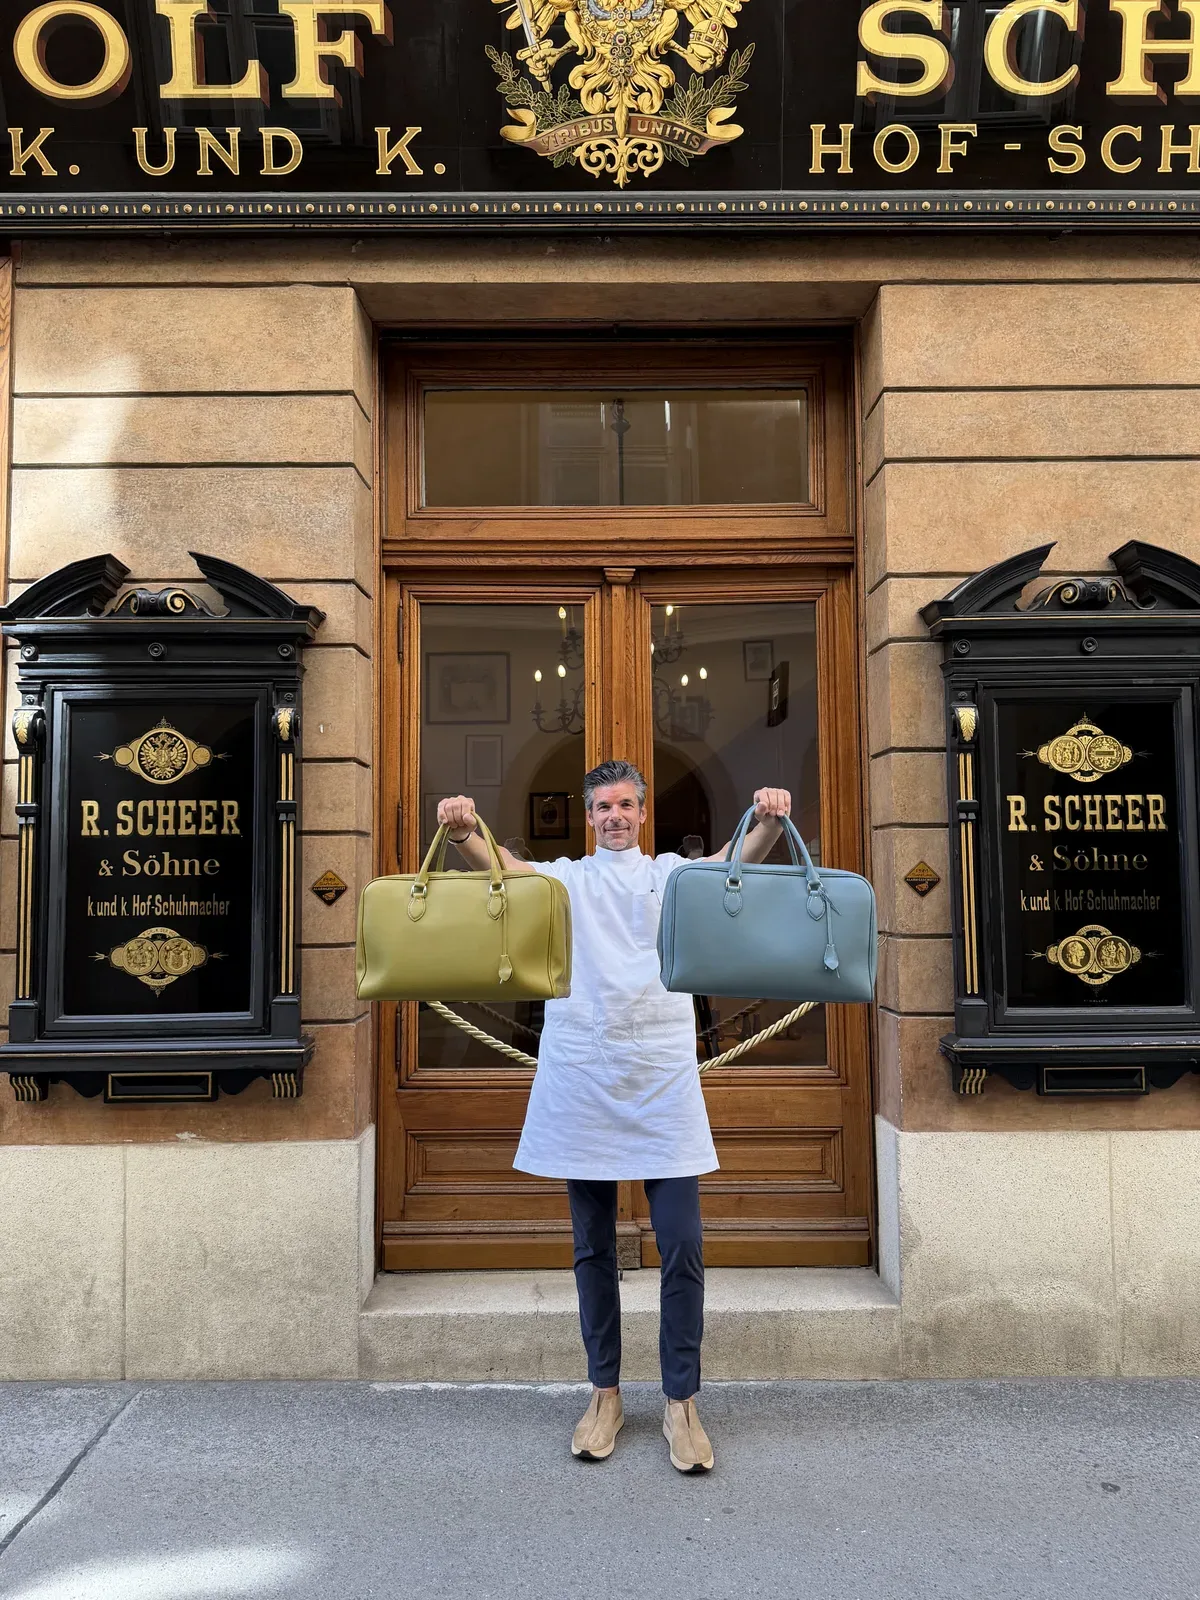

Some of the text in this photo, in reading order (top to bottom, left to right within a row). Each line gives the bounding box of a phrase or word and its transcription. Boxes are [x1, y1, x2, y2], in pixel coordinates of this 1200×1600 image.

[13, 0, 1200, 101] OLF SCH
[637, 119, 701, 149] UNITIS
[8, 127, 80, 176] K.
[132, 127, 303, 176] UND
[374, 127, 447, 176] K.
[81, 800, 241, 836] R. SCHEER
[1006, 794, 1168, 832] R. SCHEER
[98, 850, 220, 876] & Söhne
[1029, 845, 1148, 871] & Söhne
[132, 893, 230, 917] Hof-Schuhmacher
